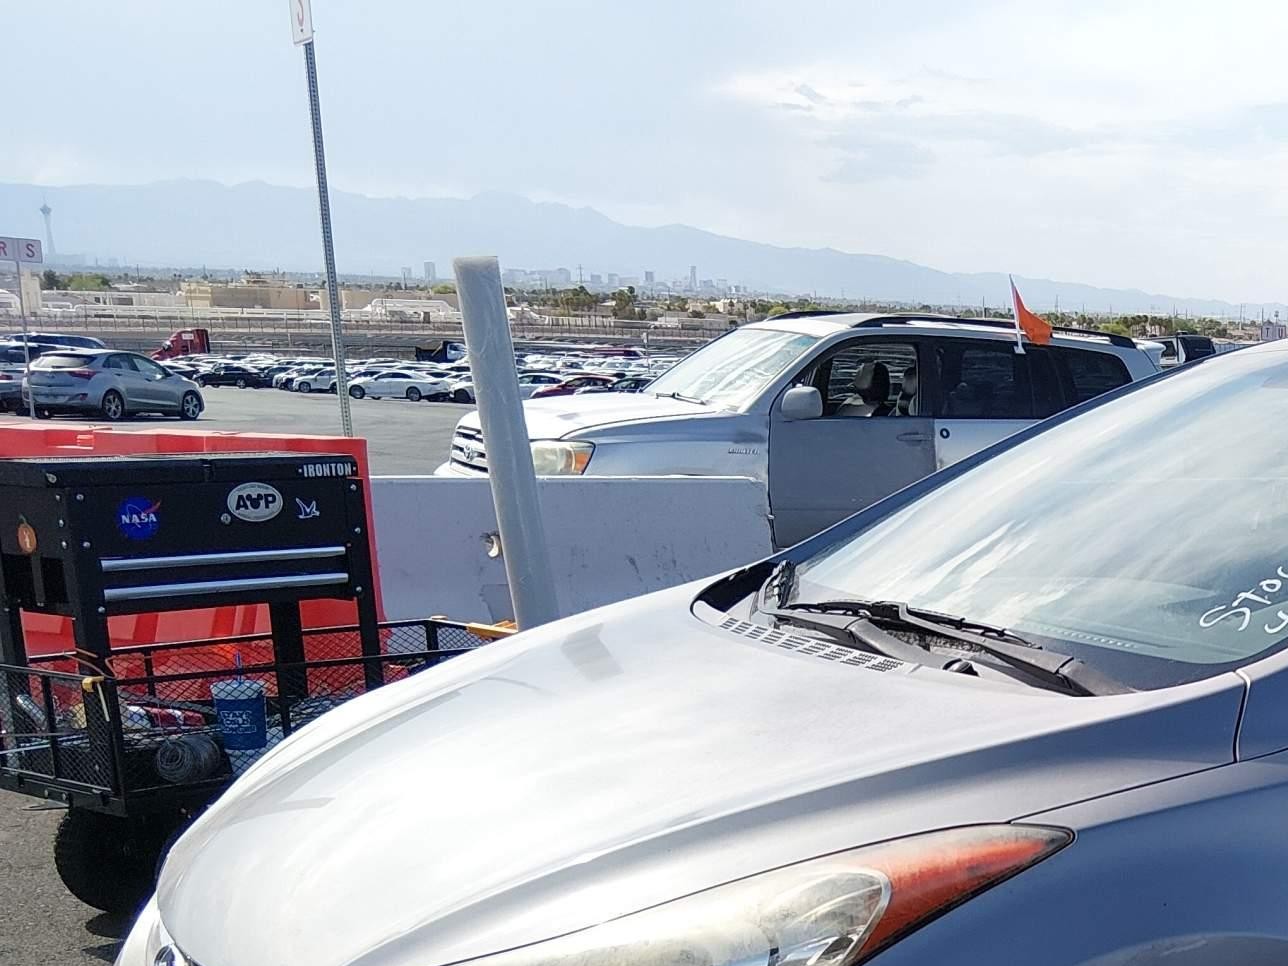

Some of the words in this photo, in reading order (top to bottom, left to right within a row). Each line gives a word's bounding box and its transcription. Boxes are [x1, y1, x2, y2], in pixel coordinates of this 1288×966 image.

[26, 243, 35, 258] S
[303, 463, 352, 477] IRONTON
[121, 513, 157, 524] NASA
